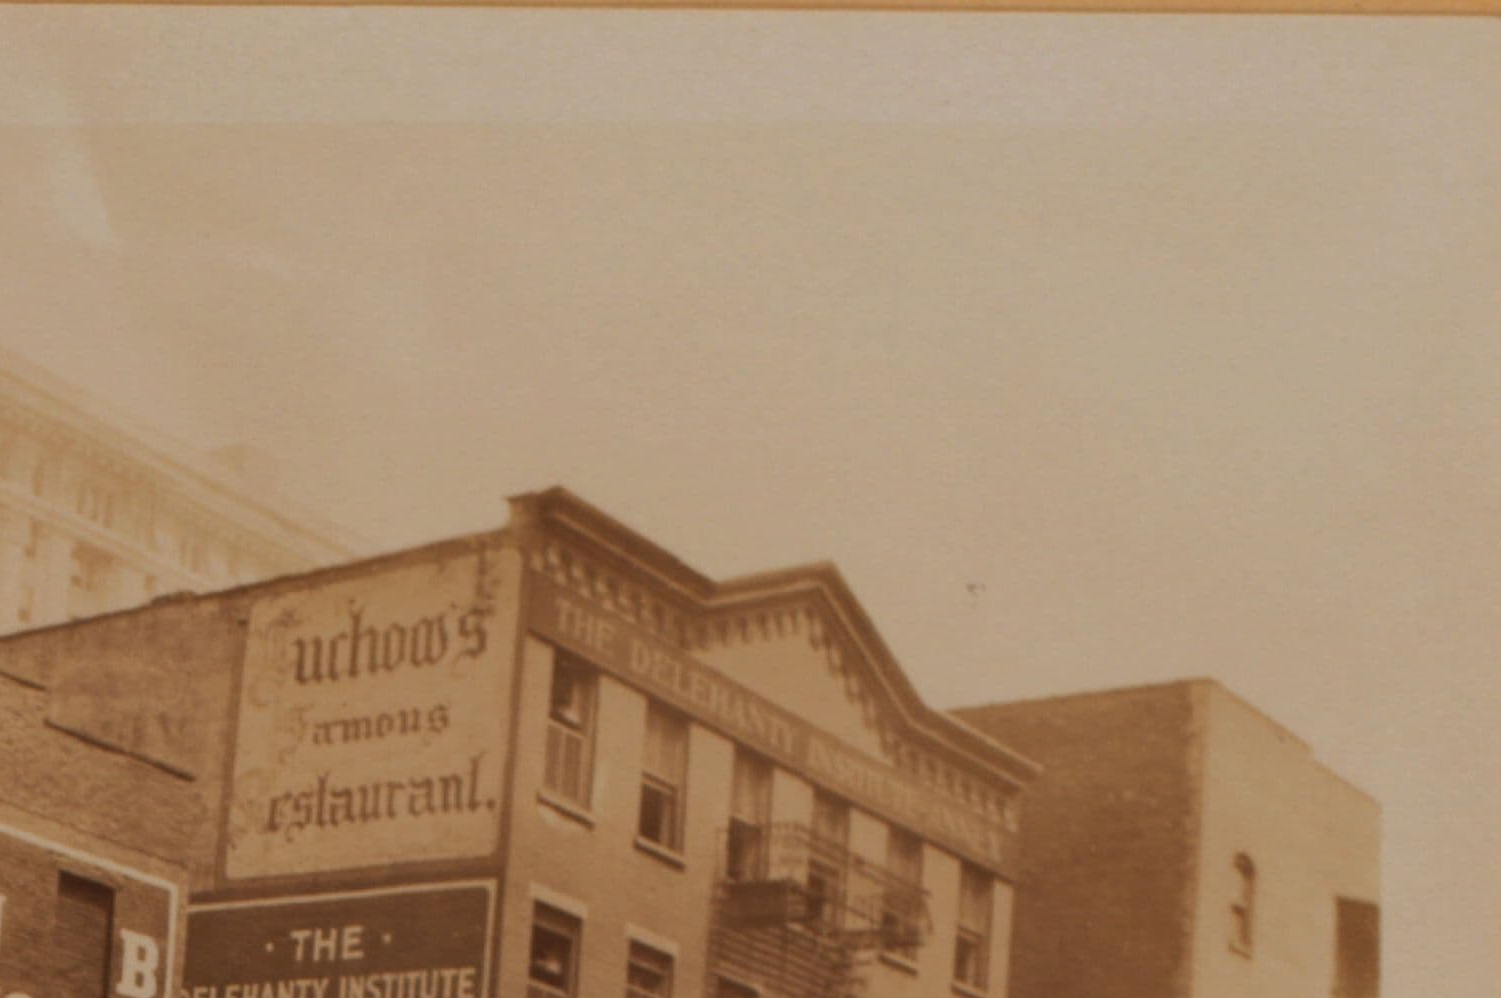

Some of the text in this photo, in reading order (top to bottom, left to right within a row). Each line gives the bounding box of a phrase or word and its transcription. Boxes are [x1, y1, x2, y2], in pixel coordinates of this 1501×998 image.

[264, 598, 496, 695] uchow's
[294, 702, 451, 750] amous
[249, 752, 497, 842] estaurant.
[289, 925, 365, 962] THE
